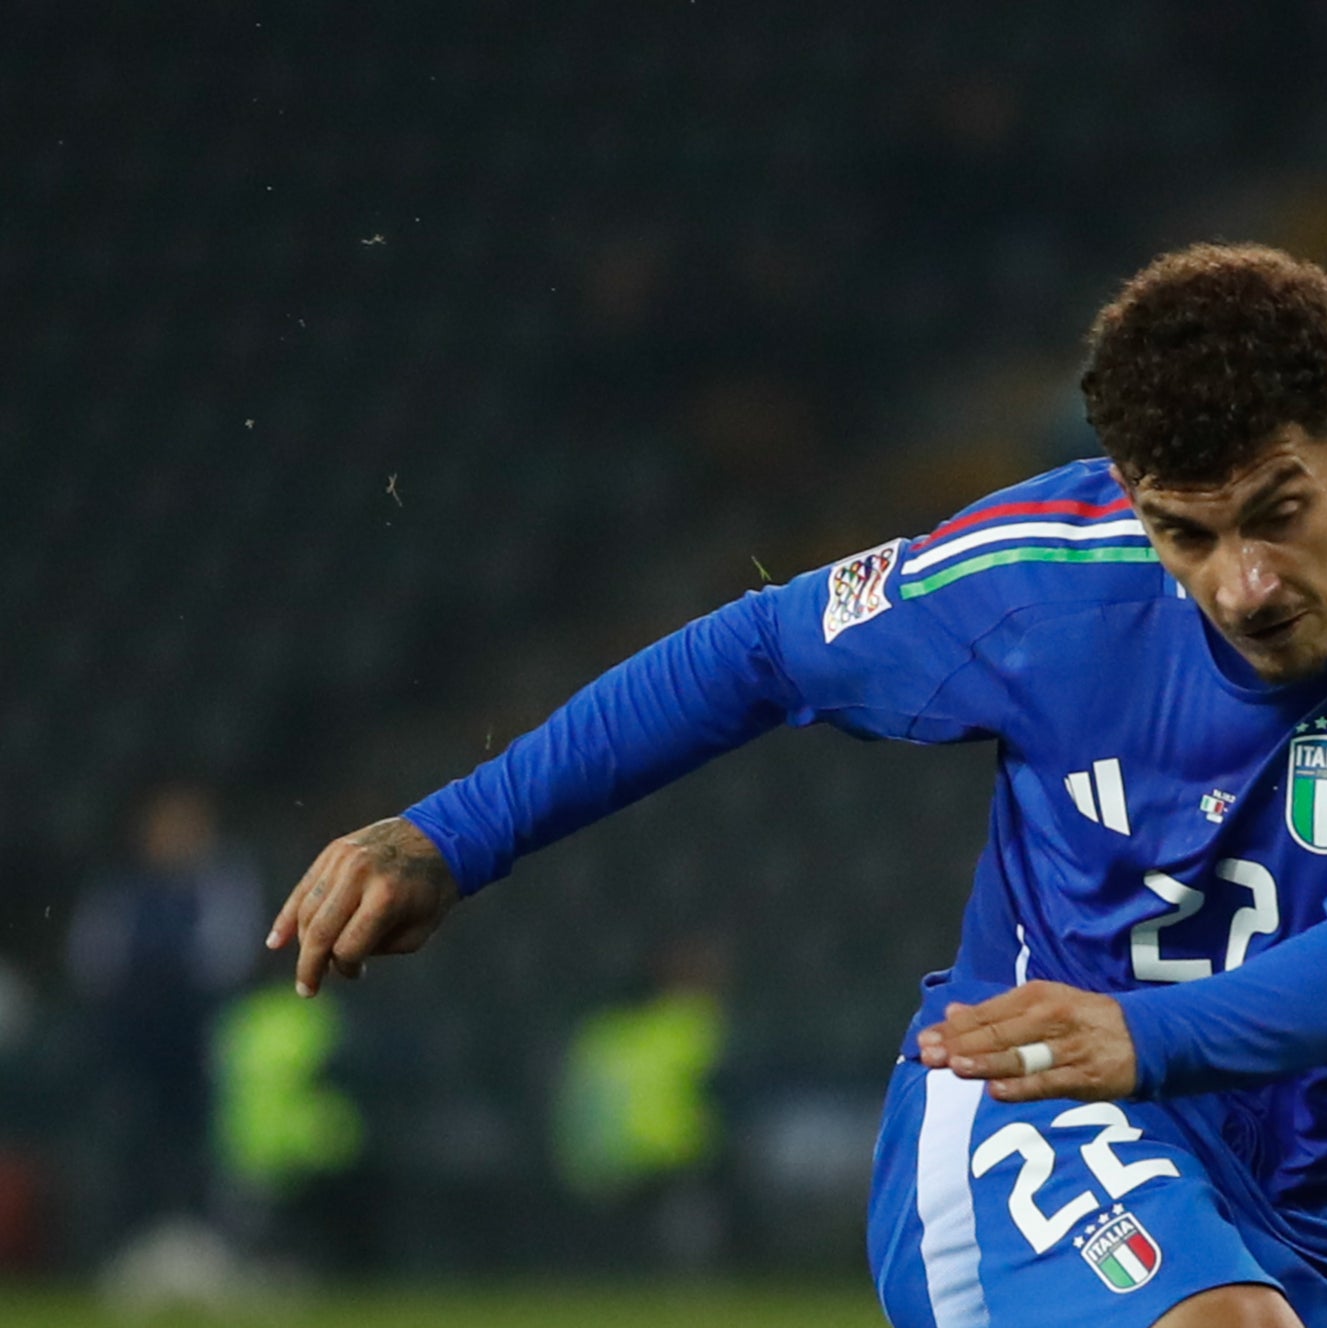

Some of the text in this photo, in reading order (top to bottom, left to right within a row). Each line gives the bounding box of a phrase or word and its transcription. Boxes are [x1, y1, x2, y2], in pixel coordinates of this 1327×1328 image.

[1130, 857, 1280, 983] 22
[971, 1101, 1181, 1255] 22
[1087, 1220, 1135, 1261] ITALIA
